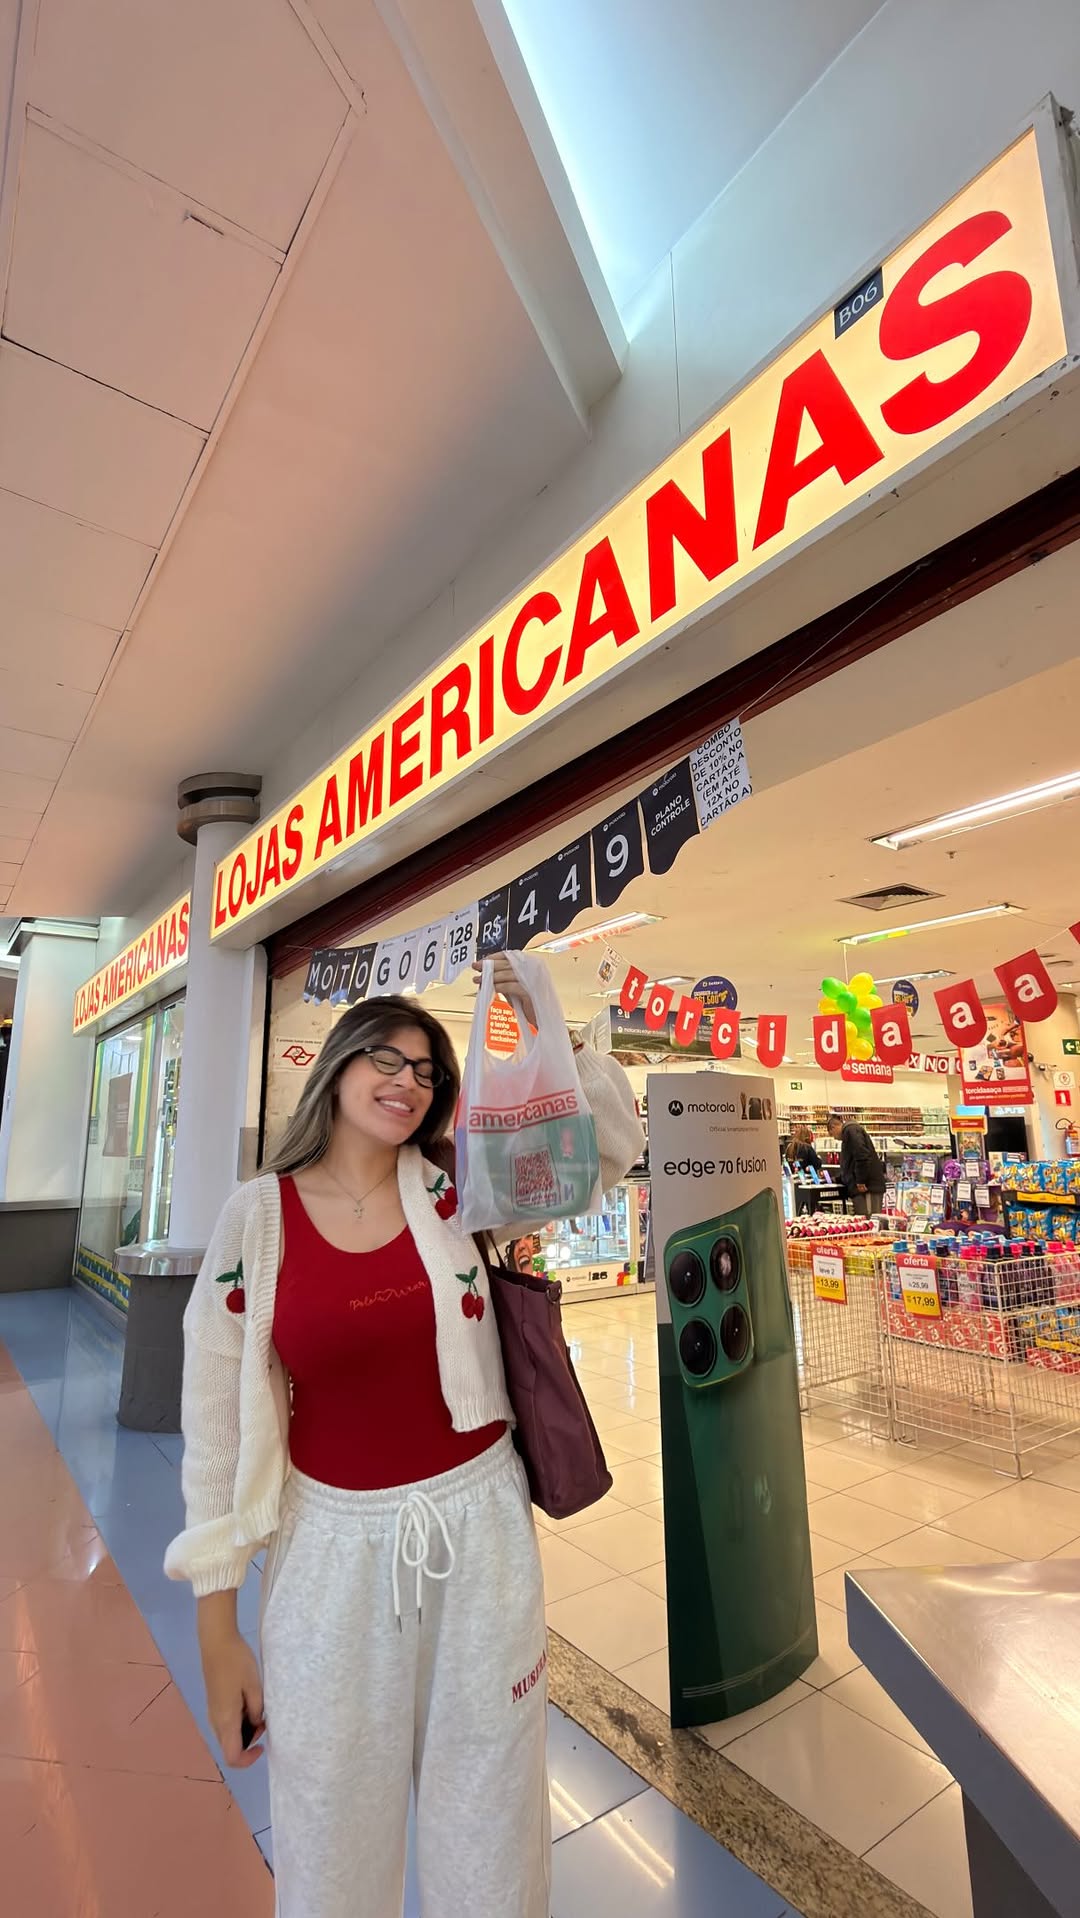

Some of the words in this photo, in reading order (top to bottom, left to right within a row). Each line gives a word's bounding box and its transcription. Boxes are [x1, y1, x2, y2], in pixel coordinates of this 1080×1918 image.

[839, 281, 878, 328] B06
[215, 804, 304, 929] LOJAS
[313, 210, 1032, 861] AMERICANAS
[691, 727, 742, 772] DESCONTO
[697, 723, 731, 755] COMBO
[694, 768, 708, 782] DE
[709, 753, 727, 771] 10%
[728, 739, 743, 755] NO
[696, 758, 735, 792] CARTÃO
[737, 751, 745, 761] A
[703, 782, 719, 801] (EM
[721, 765, 741, 786] ATÉ
[707, 792, 723, 808] 12X
[725, 779, 740, 795] NO
[651, 798, 691, 836] CONTROLE
[655, 795, 682, 822] PLANO
[700, 793, 739, 826] CARTÃO
[741, 784, 753, 797] A)
[449, 922, 473, 947] 128
[482, 914, 501, 944] R$
[75, 977, 100, 1028] LOJAS
[101, 902, 189, 1010] AMERICANAS
[450, 945, 468, 965] GB
[851, 1061, 892, 1076] semana
[925, 1056, 949, 1072] NO
[469, 1095, 578, 1129] amercanas
[687, 1102, 736, 1113] motorola
[663, 1157, 716, 1178] edge
[718, 1160, 734, 1175] 70
[736, 1156, 767, 1174] fusion
[816, 1246, 838, 1257] oferta
[903, 1256, 929, 1267] oferta
[820, 1279, 839, 1289] 13,99
[912, 1296, 936, 1307] 17,99
